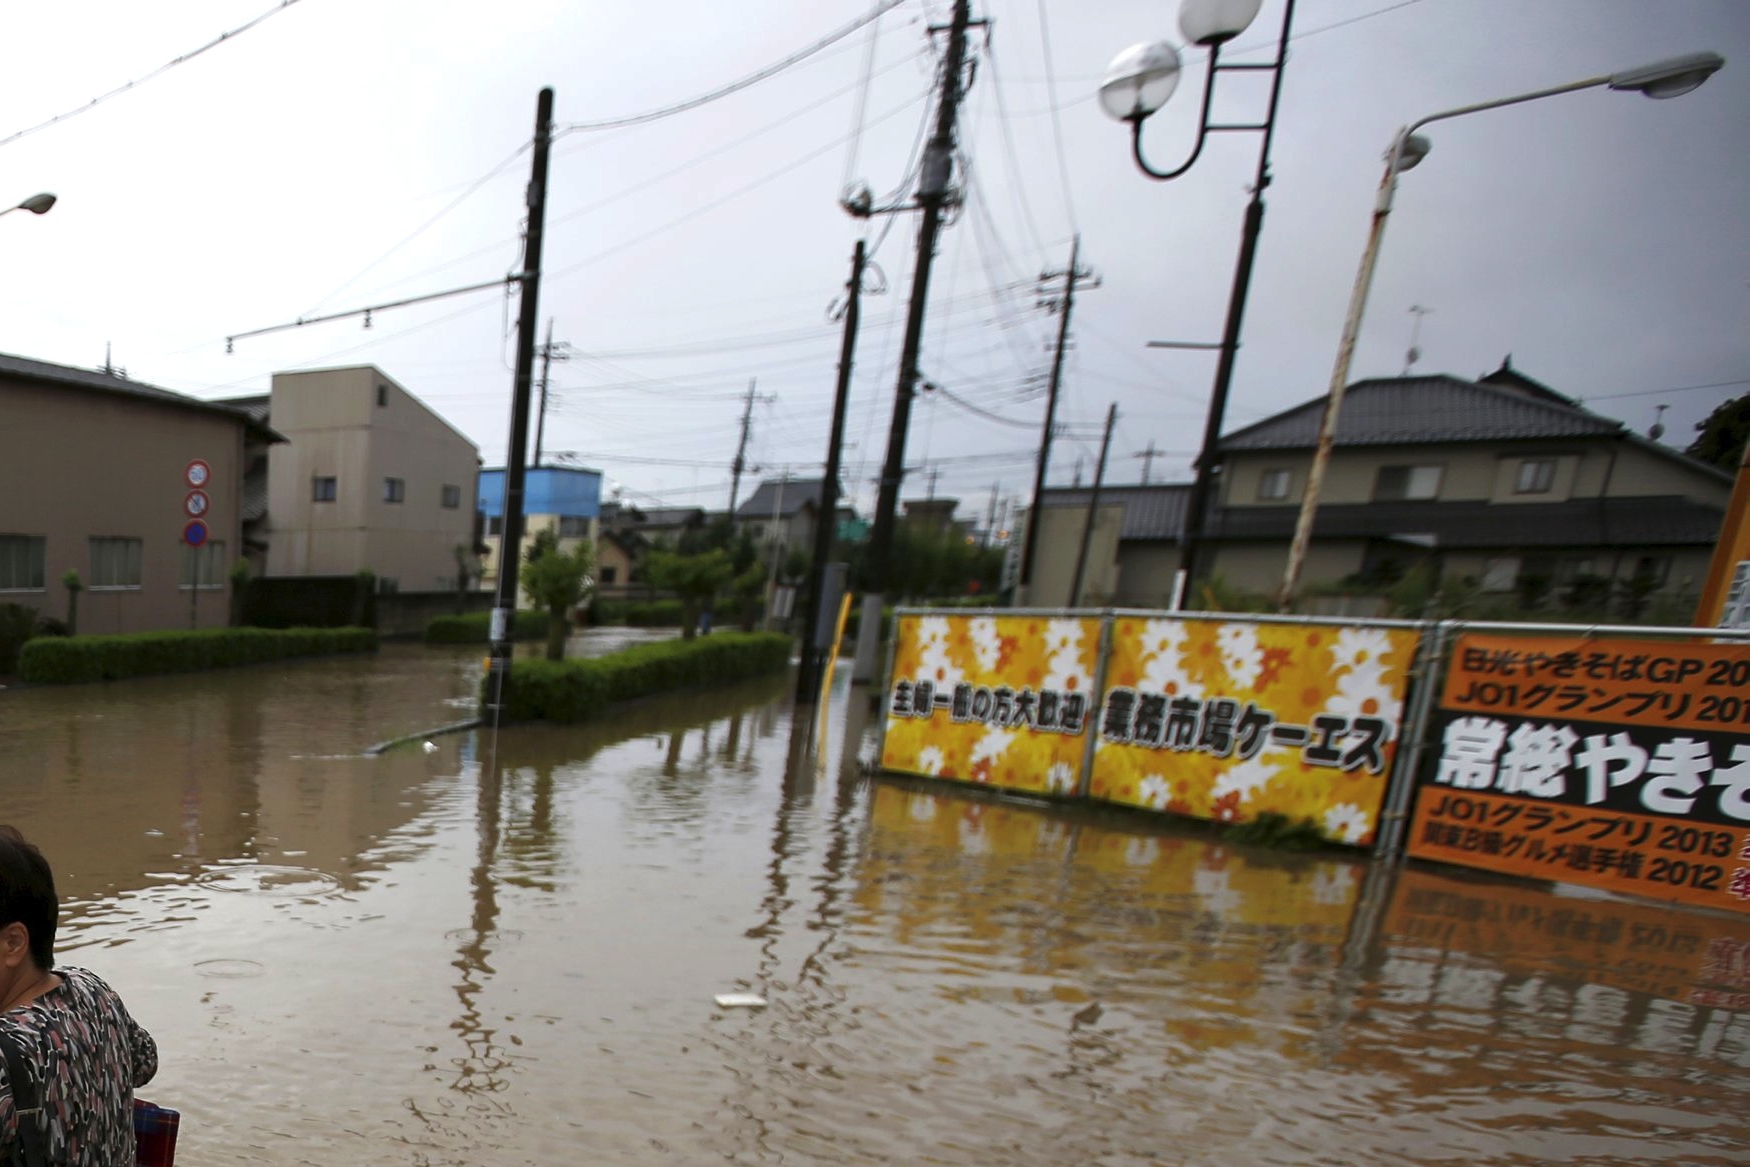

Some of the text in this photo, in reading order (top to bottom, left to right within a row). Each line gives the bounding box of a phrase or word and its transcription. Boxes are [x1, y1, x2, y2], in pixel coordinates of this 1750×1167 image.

[1102, 686, 1389, 776] 業務市場ケーエス
[1657, 825, 1735, 858] 2013
[1647, 857, 1724, 891] 2012
